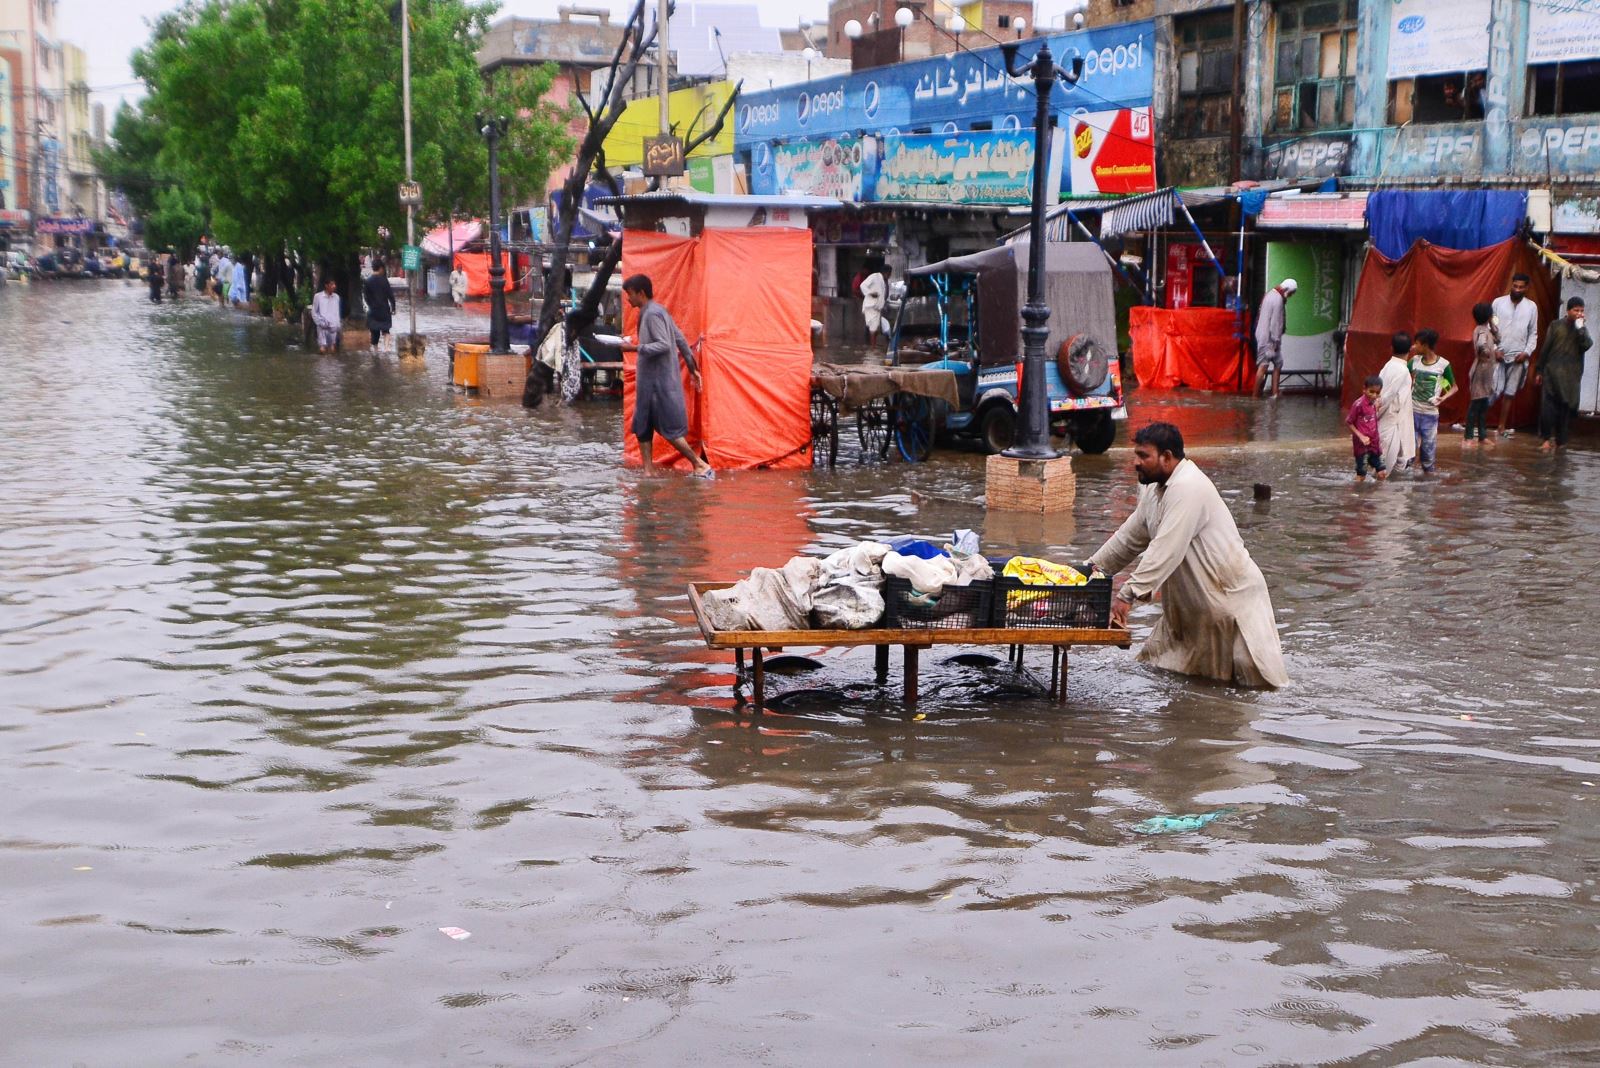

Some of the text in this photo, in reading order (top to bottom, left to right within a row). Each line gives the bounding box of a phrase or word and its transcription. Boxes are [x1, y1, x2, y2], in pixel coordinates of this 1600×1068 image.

[1084, 33, 1143, 82] pepsi
[812, 85, 844, 117] pepsi
[959, 58, 1004, 105] مسافر
[751, 98, 779, 128] pepsi
[1321, 249, 1335, 320] SHAFAY
